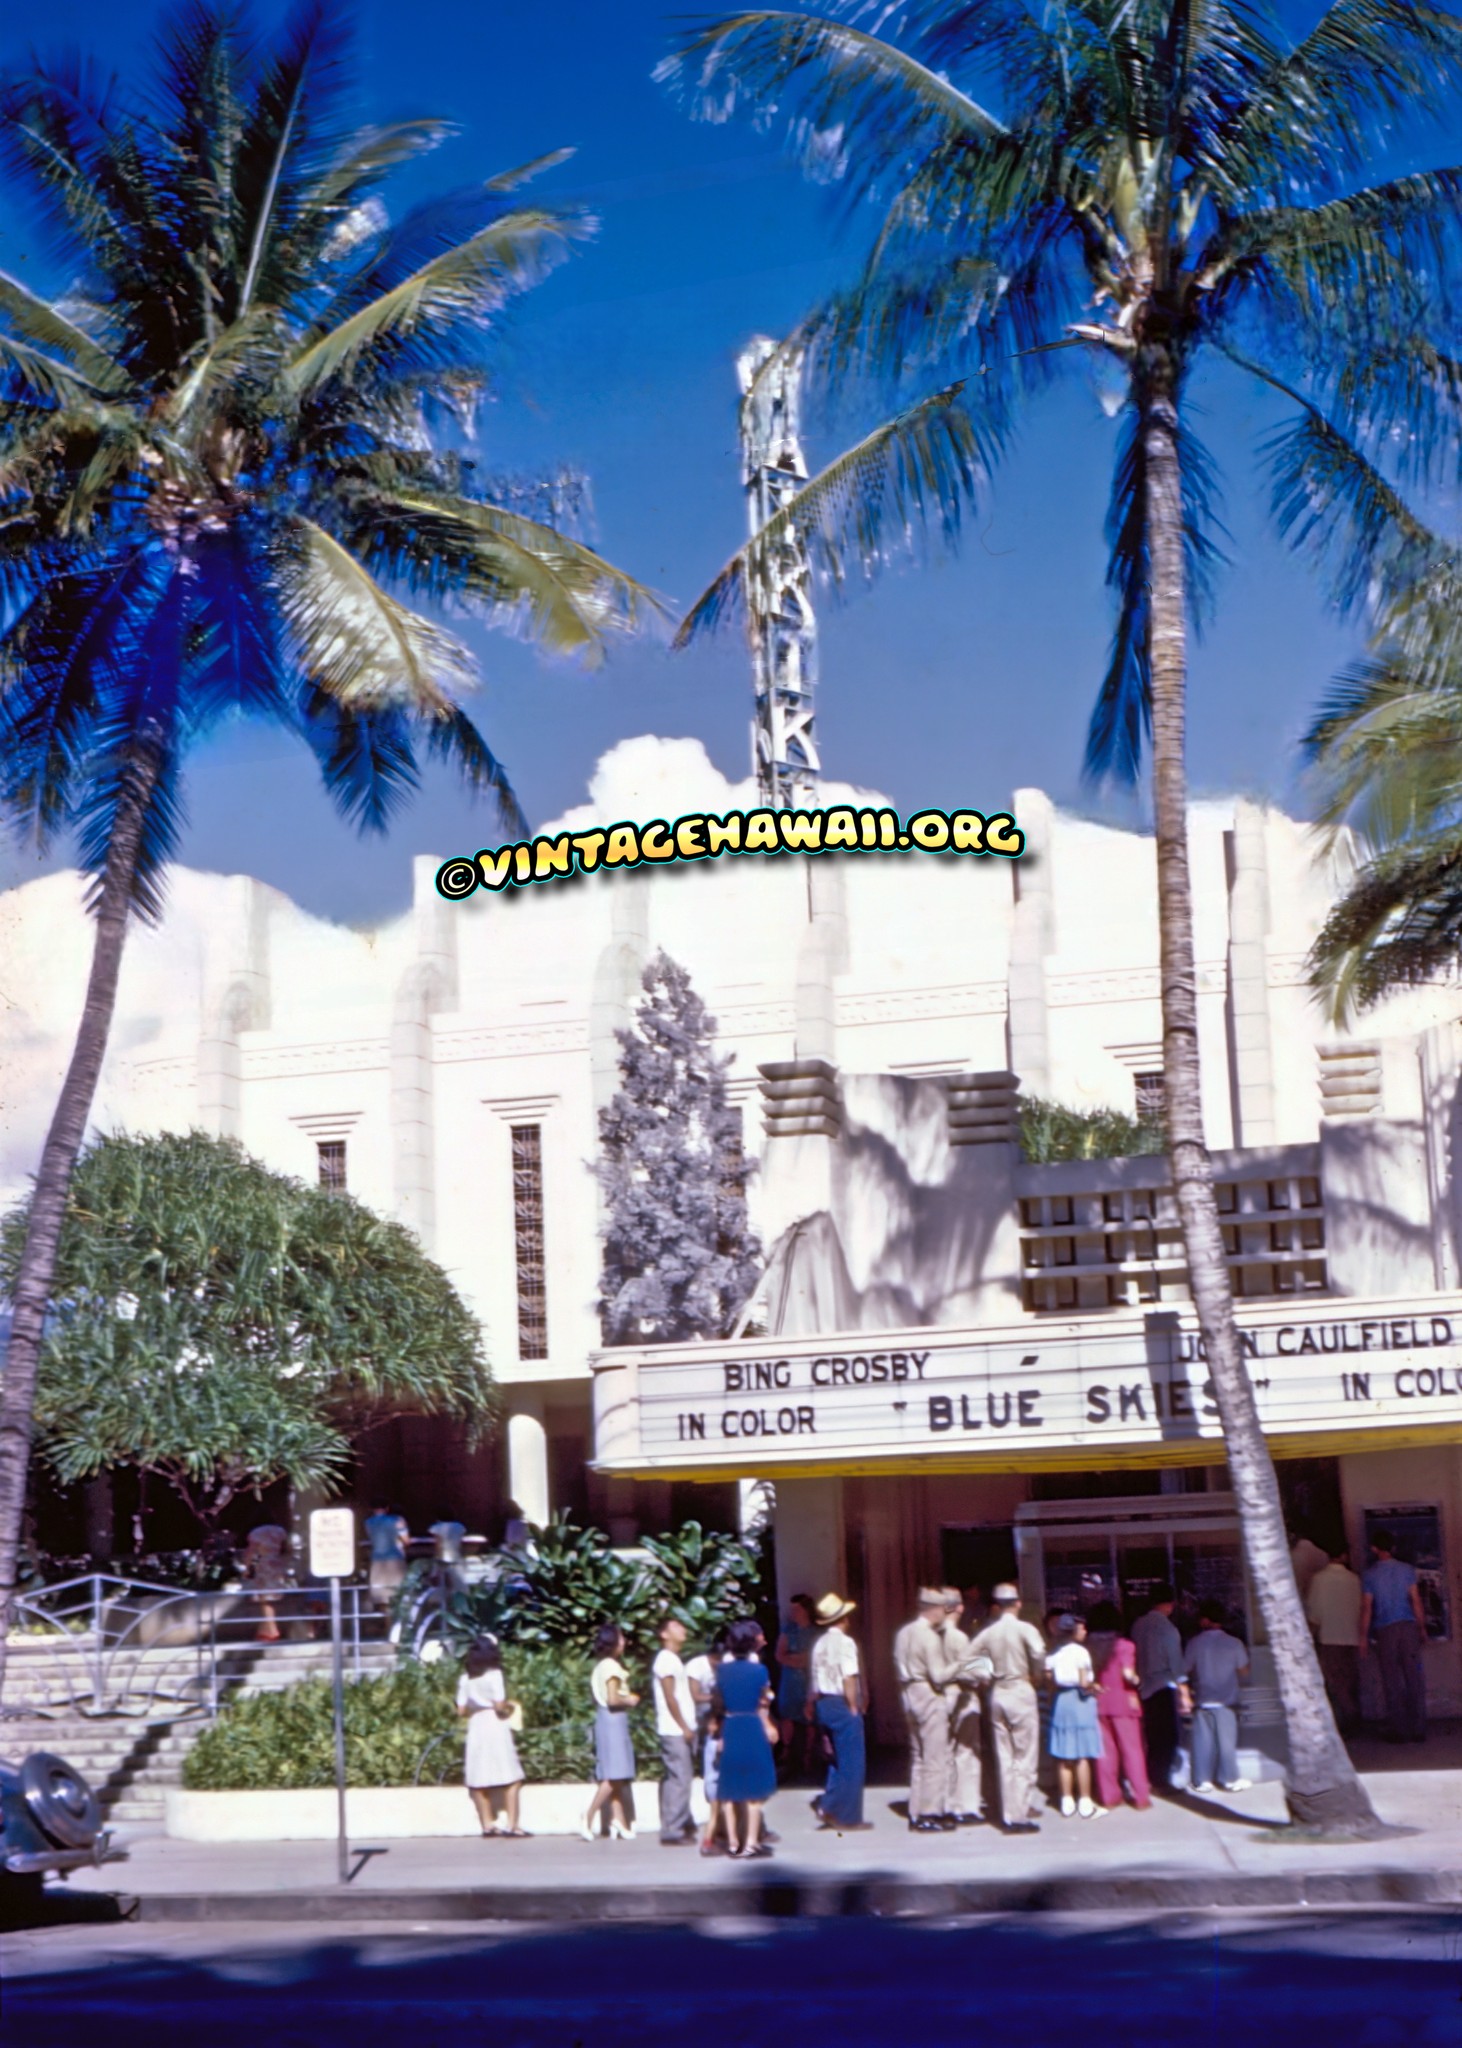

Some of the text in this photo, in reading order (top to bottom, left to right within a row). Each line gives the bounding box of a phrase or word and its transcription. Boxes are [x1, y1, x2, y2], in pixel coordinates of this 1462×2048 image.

[725, 1361, 791, 1391] BING
[811, 1352, 931, 1387] CROSBY
[1178, 1331, 1259, 1362] JN
[1276, 1318, 1452, 1356] CAULFIELD
[1341, 1367, 1462, 1401] IN COL
[678, 1407, 817, 1441] IN COLOR
